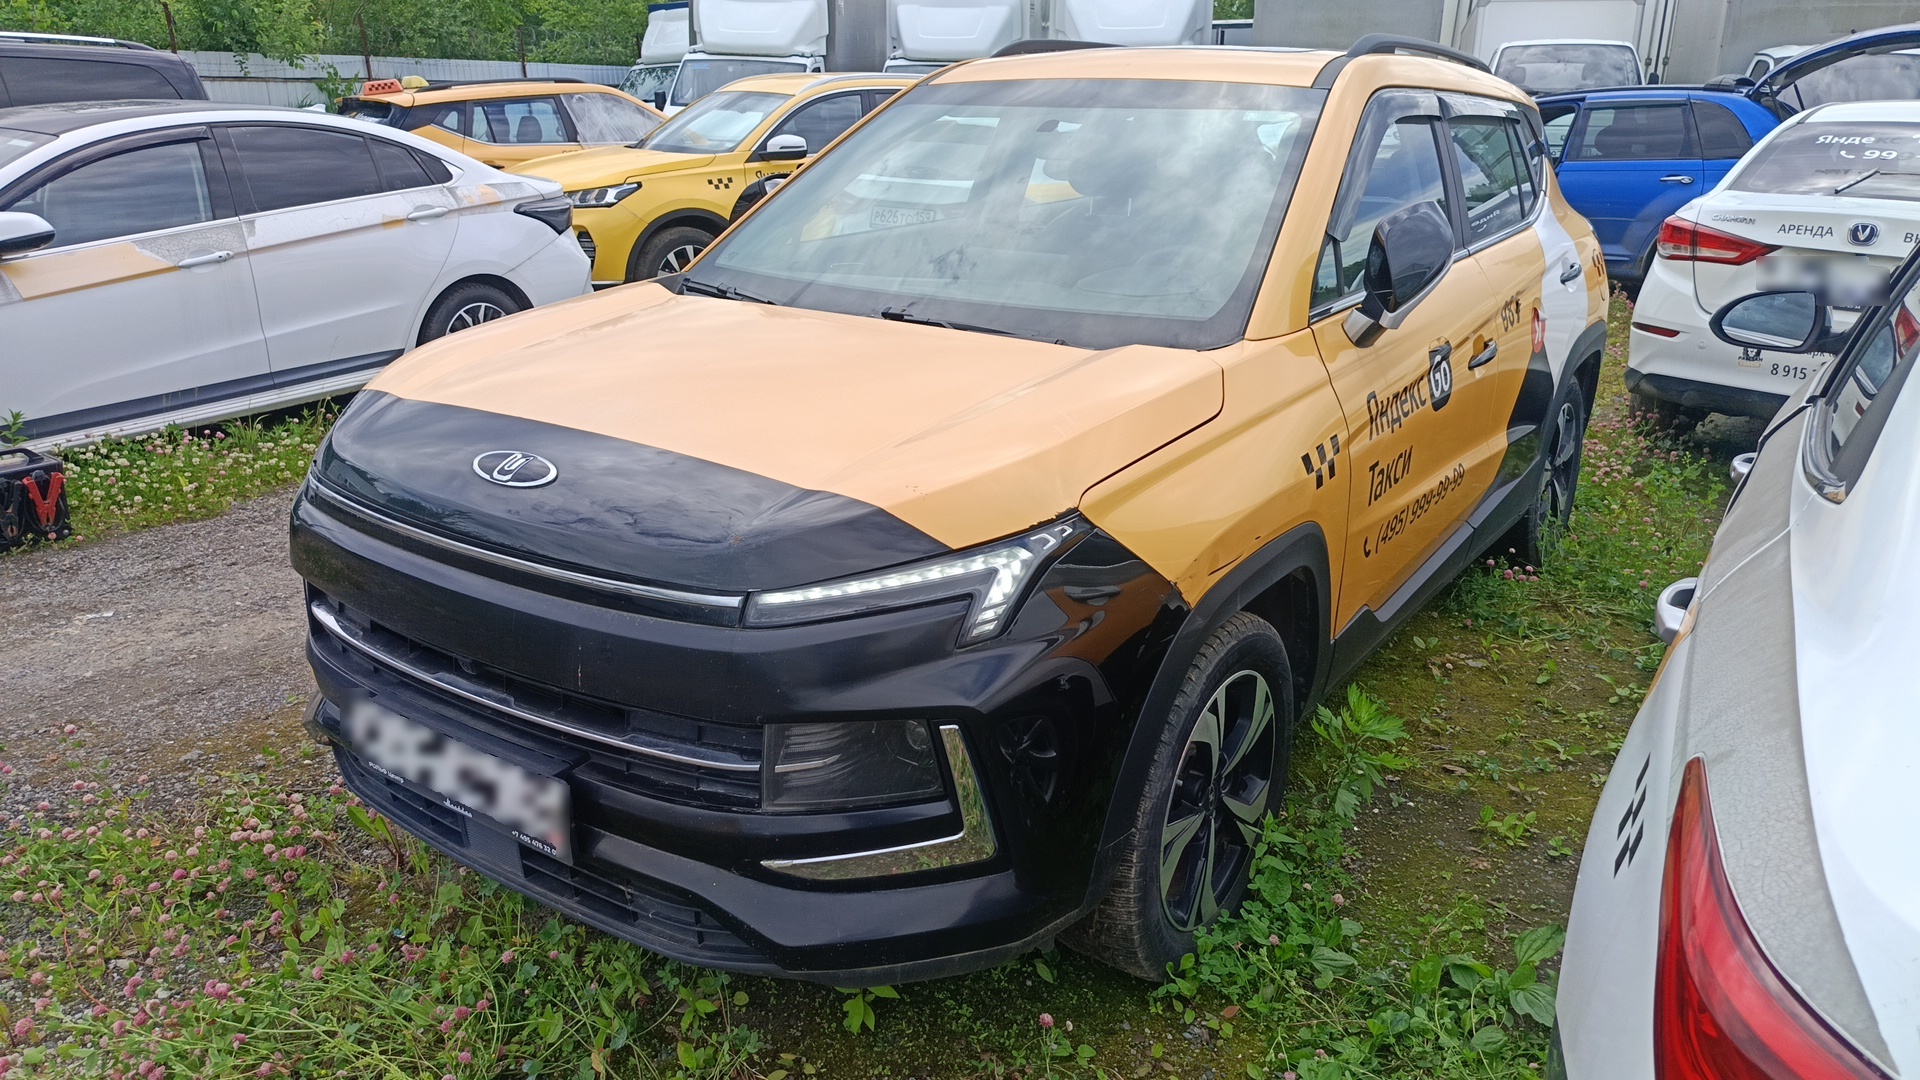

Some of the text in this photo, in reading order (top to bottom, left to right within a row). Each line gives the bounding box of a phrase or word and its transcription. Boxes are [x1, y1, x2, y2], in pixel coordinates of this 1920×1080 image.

[1777, 224, 1834, 239] АРЕНДА
[1366, 354, 1450, 441] Яндекс Go
[1770, 363, 1779, 376] 8
[1782, 364, 1808, 380] 915
[1367, 445, 1414, 507] Такси
[1374, 462, 1466, 554] (495) 999-99-99
